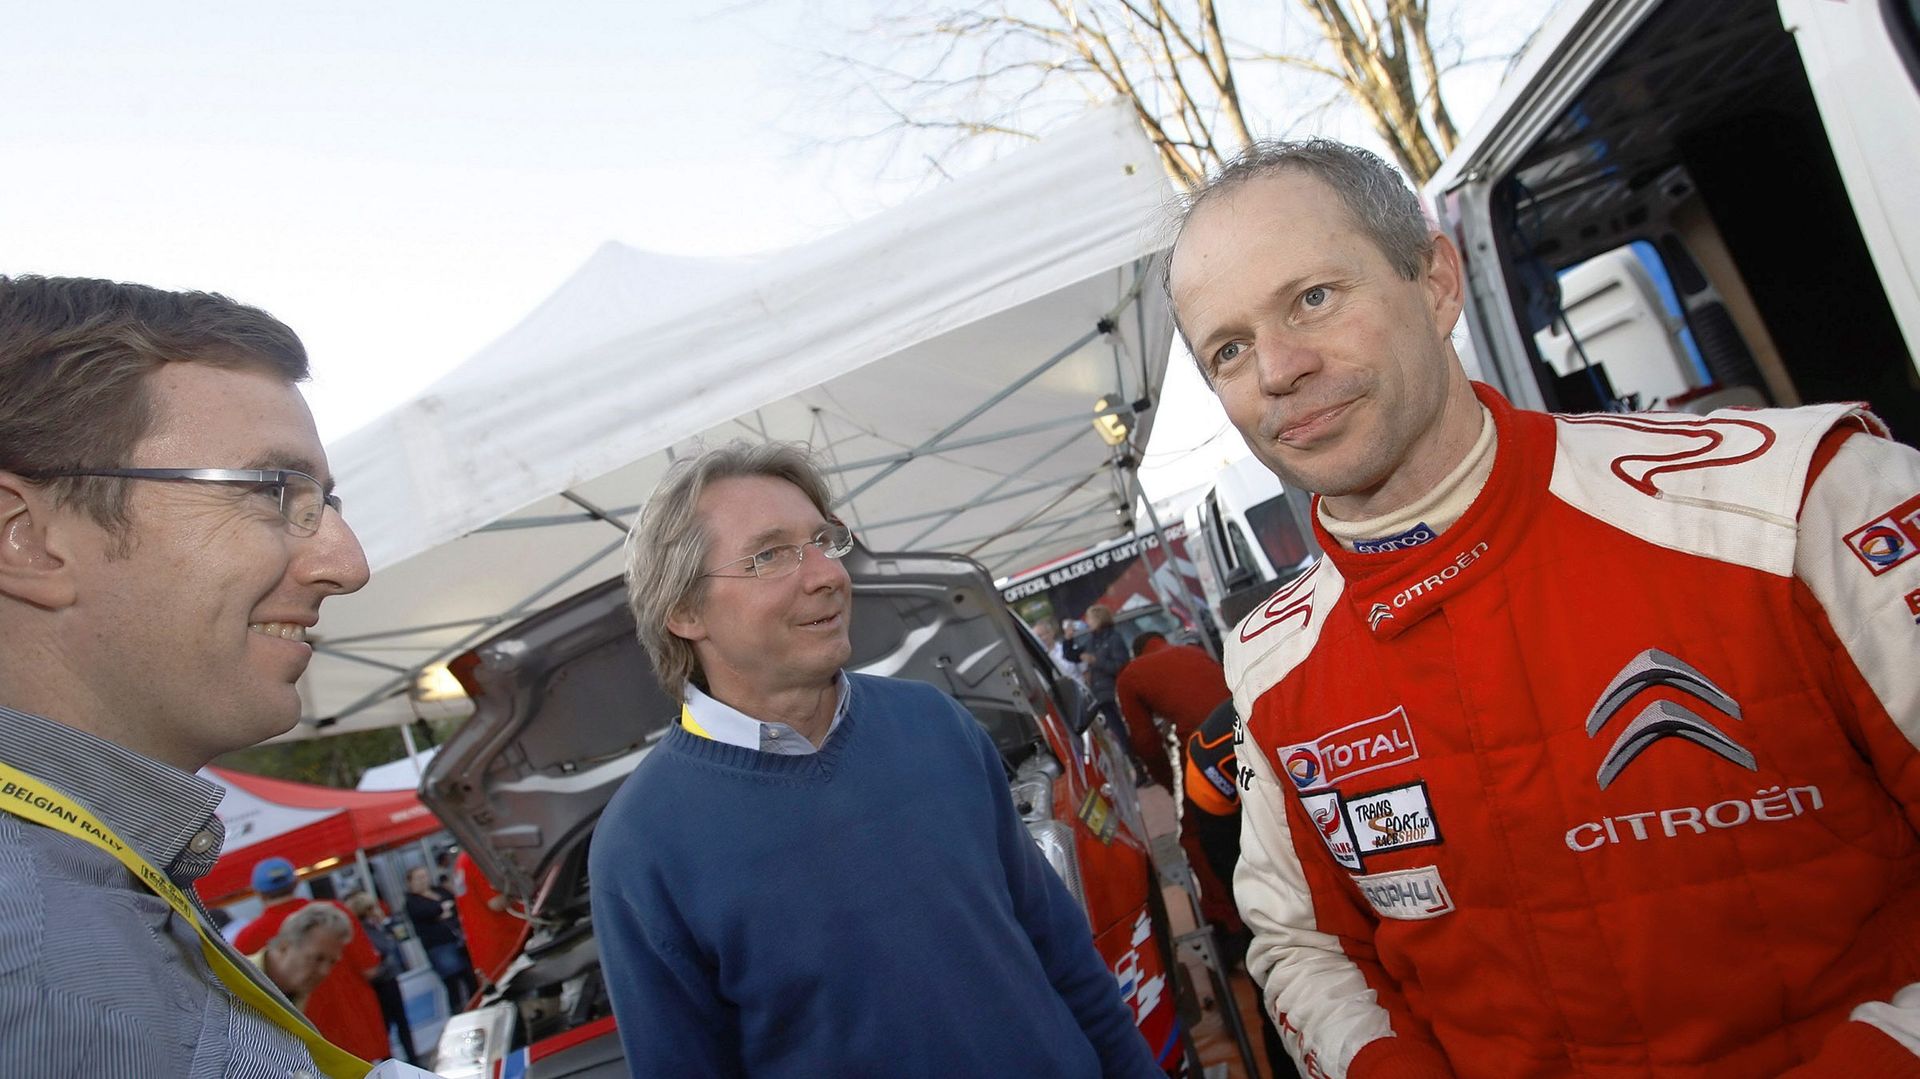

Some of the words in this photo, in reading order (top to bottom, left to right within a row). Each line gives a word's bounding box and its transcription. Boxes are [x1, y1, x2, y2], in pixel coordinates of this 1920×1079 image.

[1003, 580, 1050, 603] OFFICIAL
[1050, 559, 1096, 585] BUILDER
[1095, 551, 1113, 569] OF
[1320, 728, 1410, 772] TOTAL
[2, 781, 78, 824] BELGIAN
[80, 820, 123, 851] RALLY
[1355, 799, 1393, 823] TRANS
